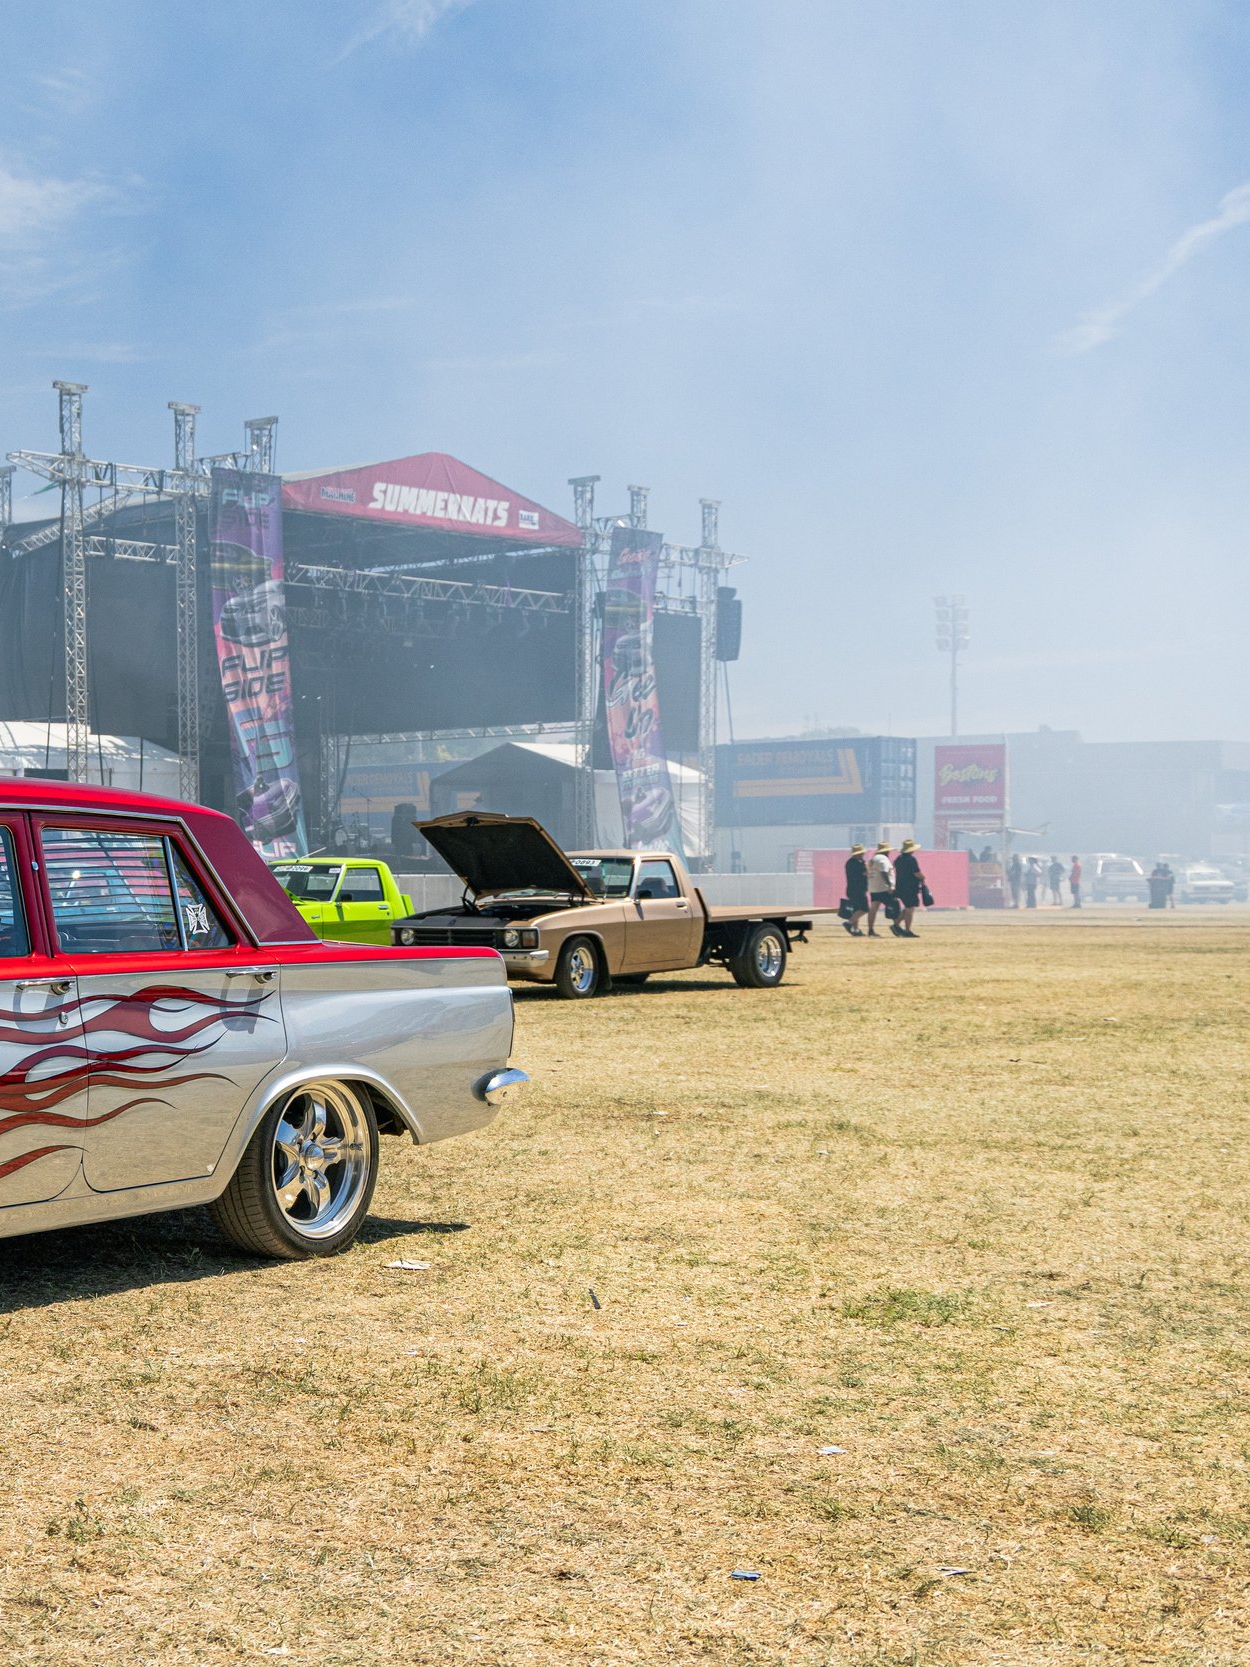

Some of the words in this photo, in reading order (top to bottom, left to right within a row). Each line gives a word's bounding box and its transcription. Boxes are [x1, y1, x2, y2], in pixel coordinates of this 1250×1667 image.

[367, 482, 510, 527] SUMMERNATS
[222, 646, 289, 677] FLIP
[224, 672, 285, 702] SIDE
